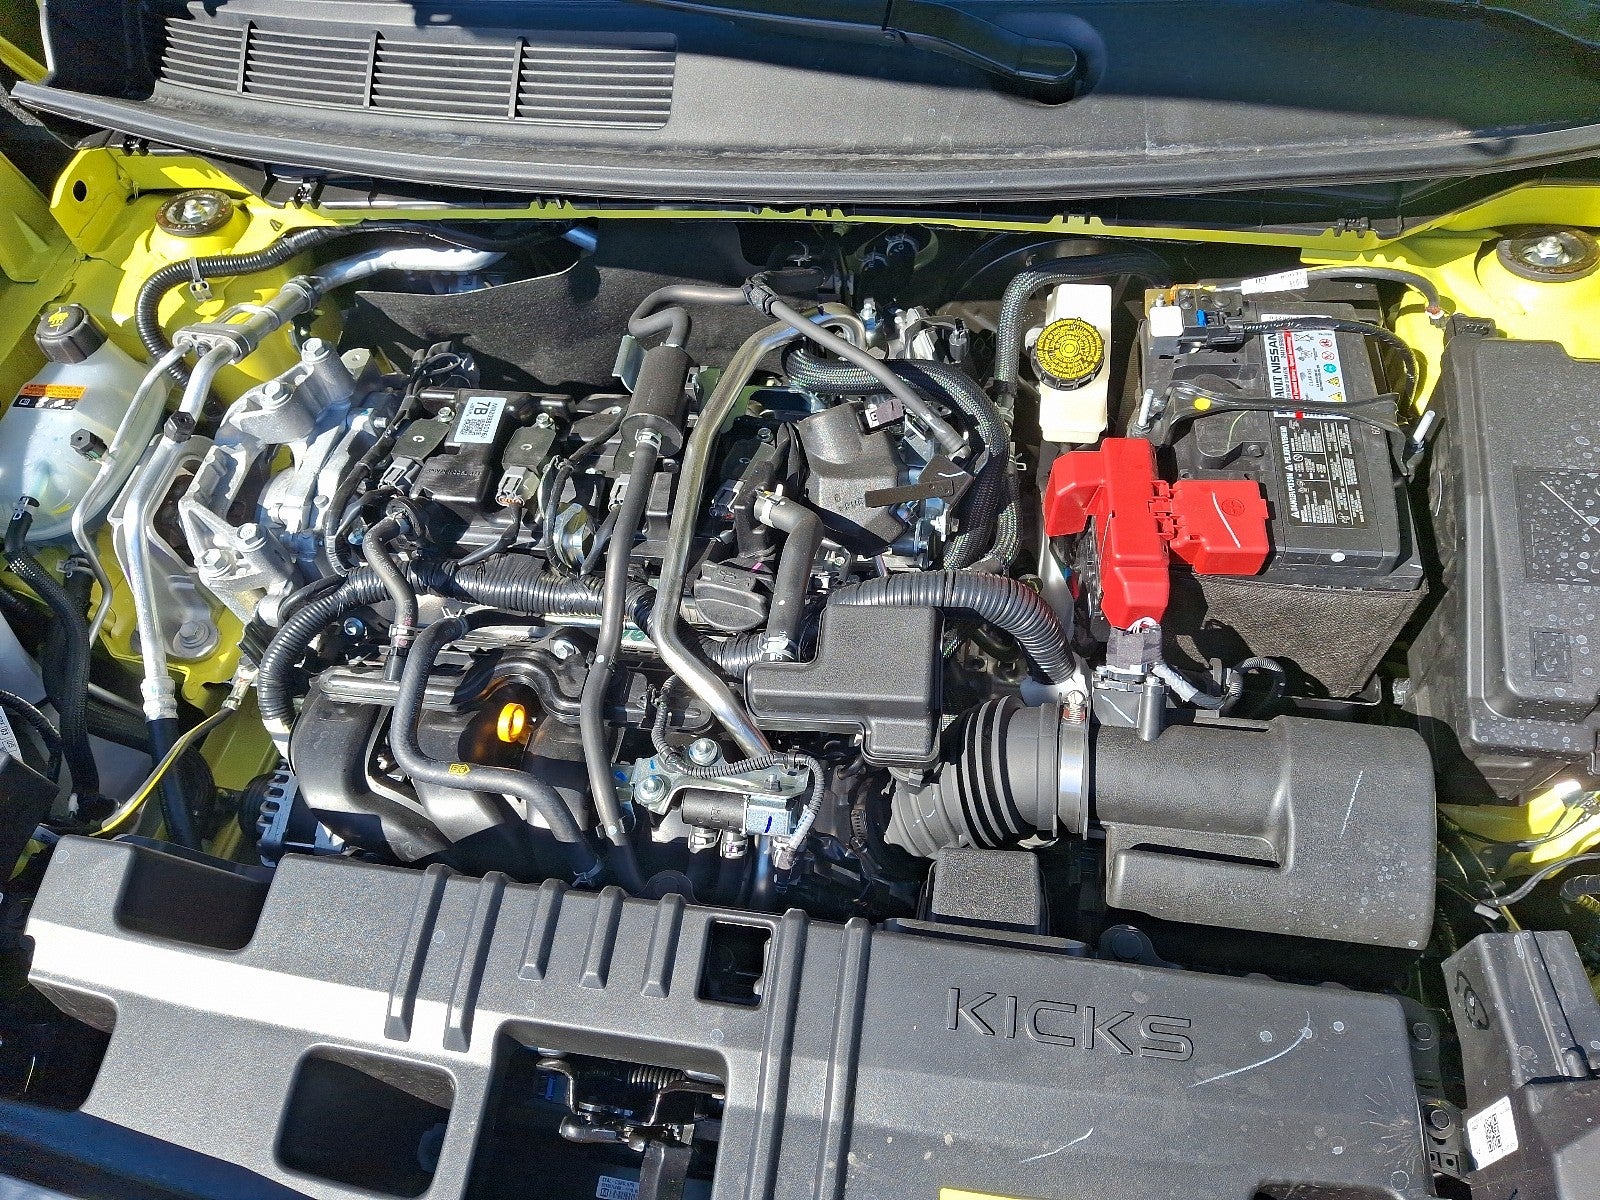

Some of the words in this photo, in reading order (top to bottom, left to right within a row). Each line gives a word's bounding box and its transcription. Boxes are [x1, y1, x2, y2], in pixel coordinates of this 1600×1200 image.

[1267, 332, 1281, 373] NISSAN
[473, 401, 492, 415] 7B
[947, 987, 1194, 1062] KICKS
